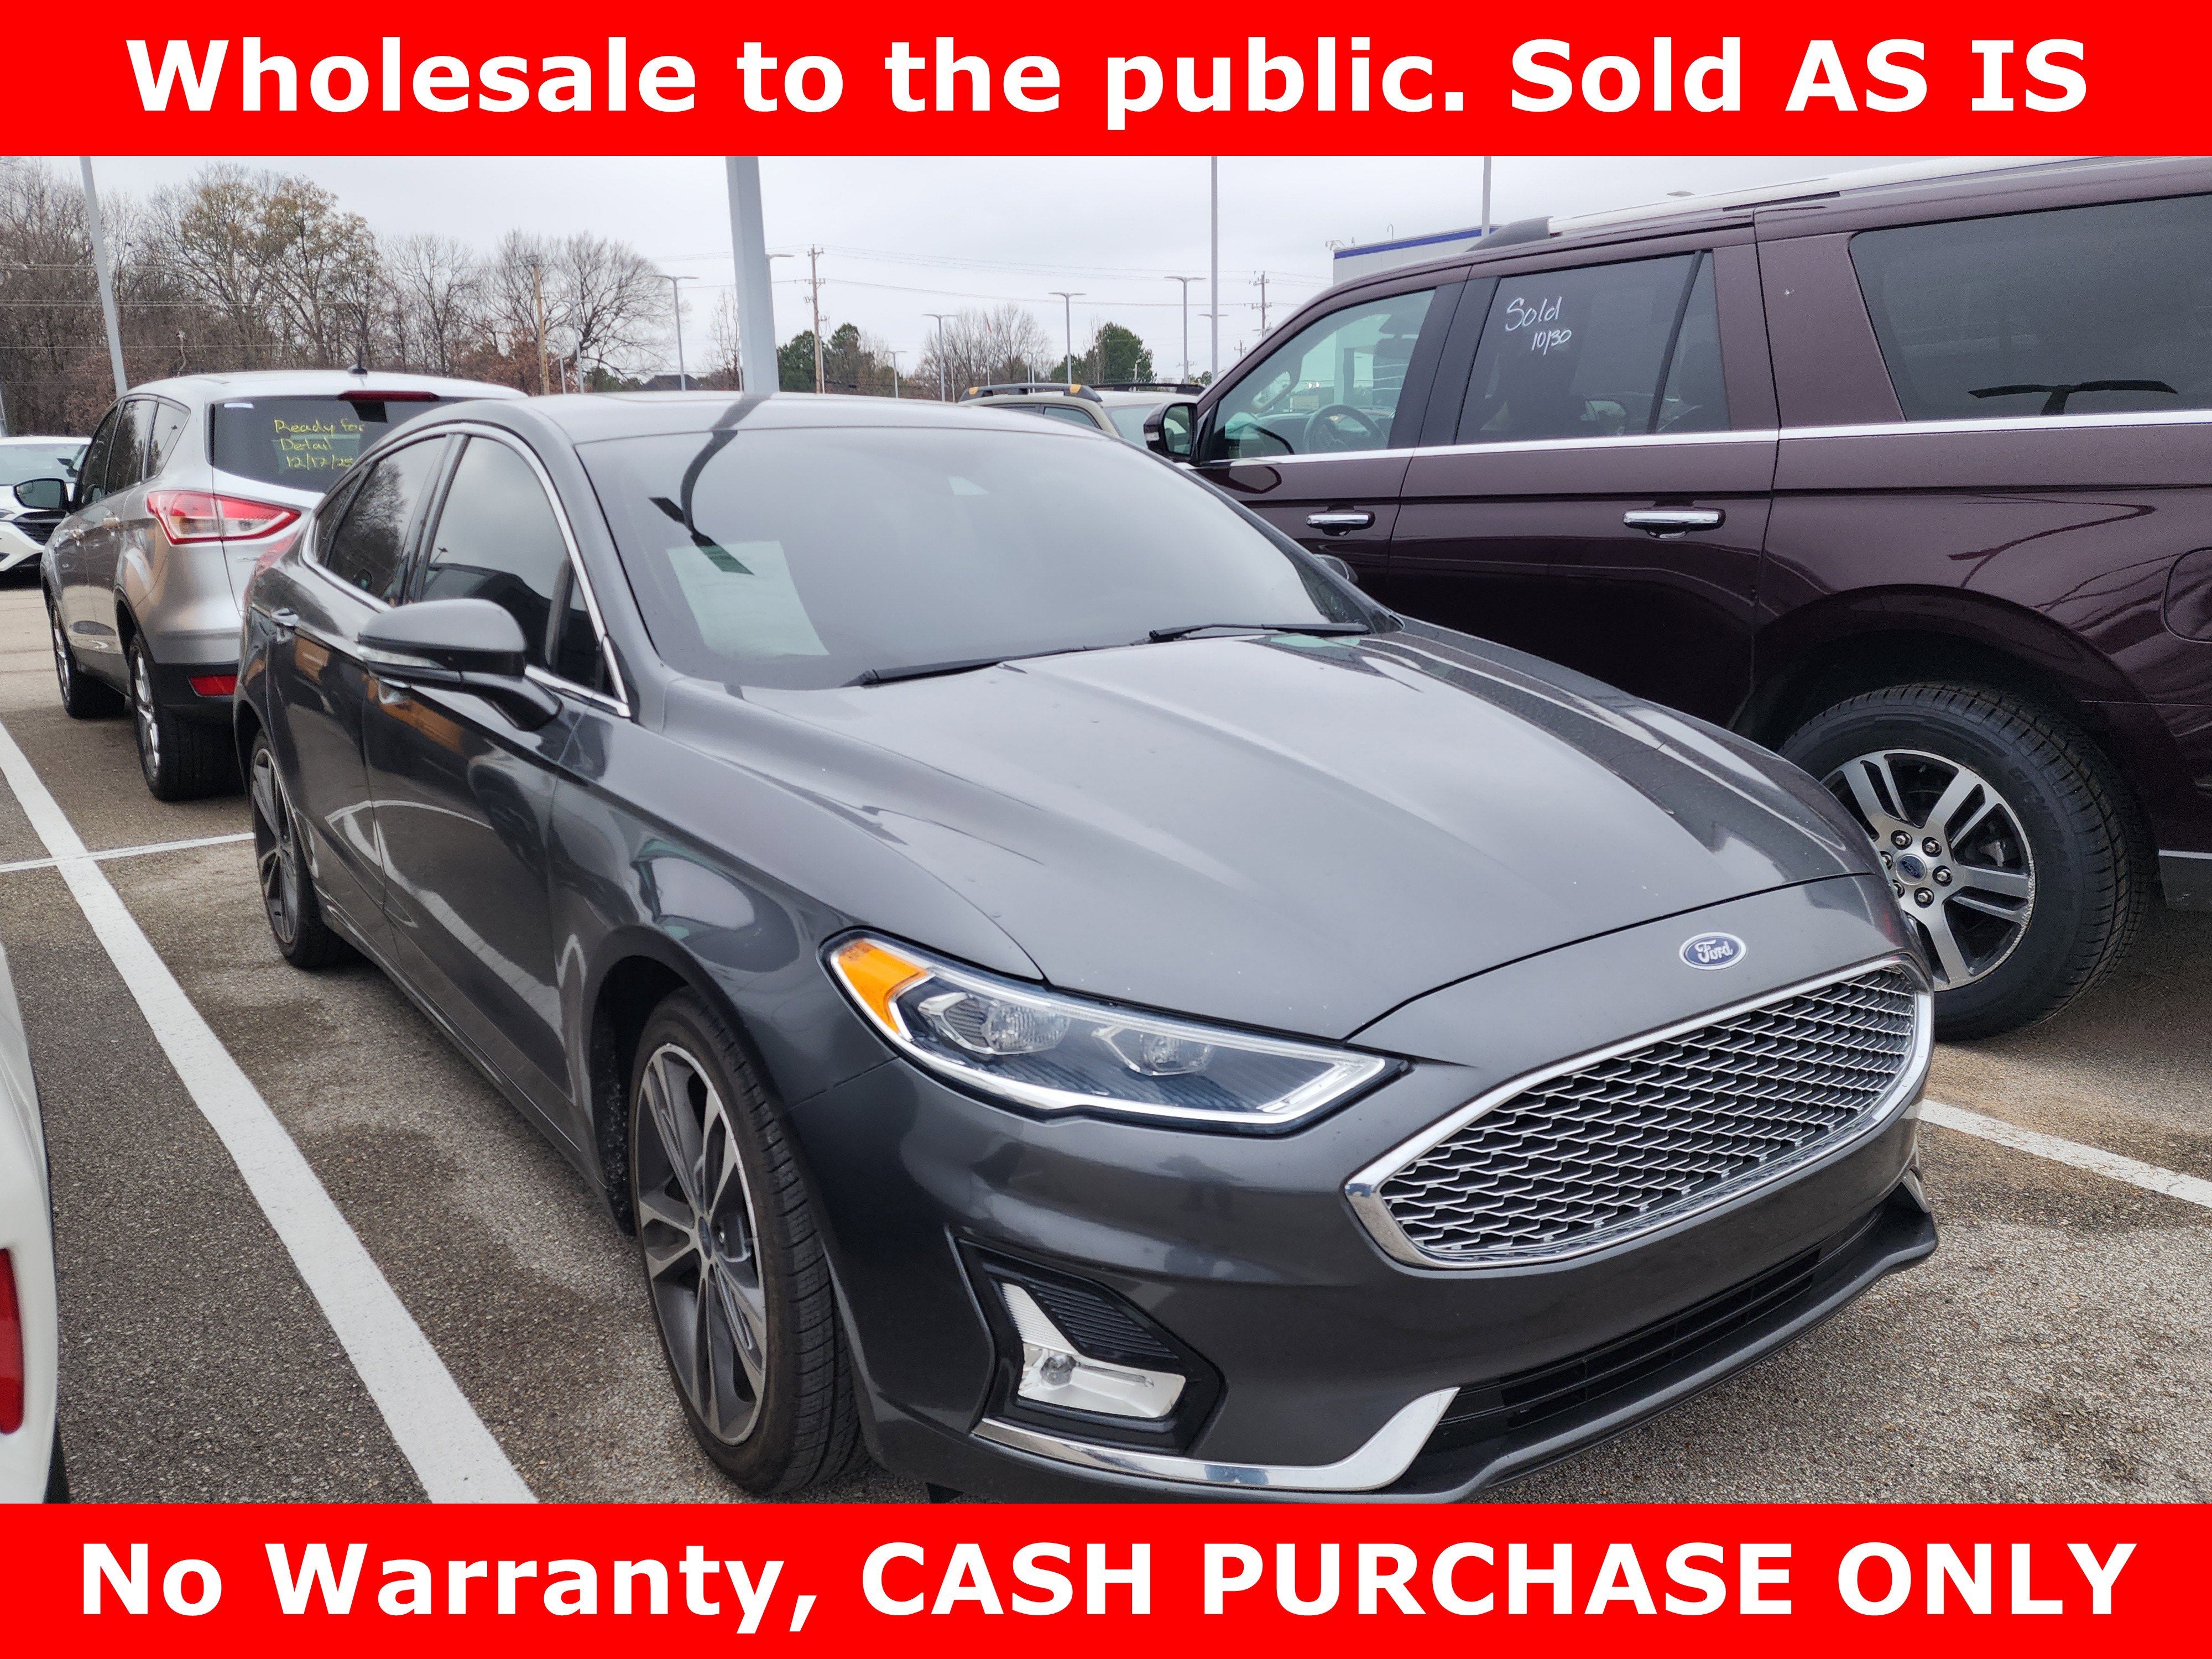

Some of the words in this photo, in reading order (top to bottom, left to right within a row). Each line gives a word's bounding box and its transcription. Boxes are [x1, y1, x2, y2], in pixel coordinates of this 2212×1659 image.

[1505, 295, 1563, 332] Sold
[1531, 329, 1572, 356] 10/30
[274, 418, 335, 437] Ready
[340, 418, 365, 432] for
[280, 436, 332, 451] Detail
[1694, 939, 1734, 963] Ford
